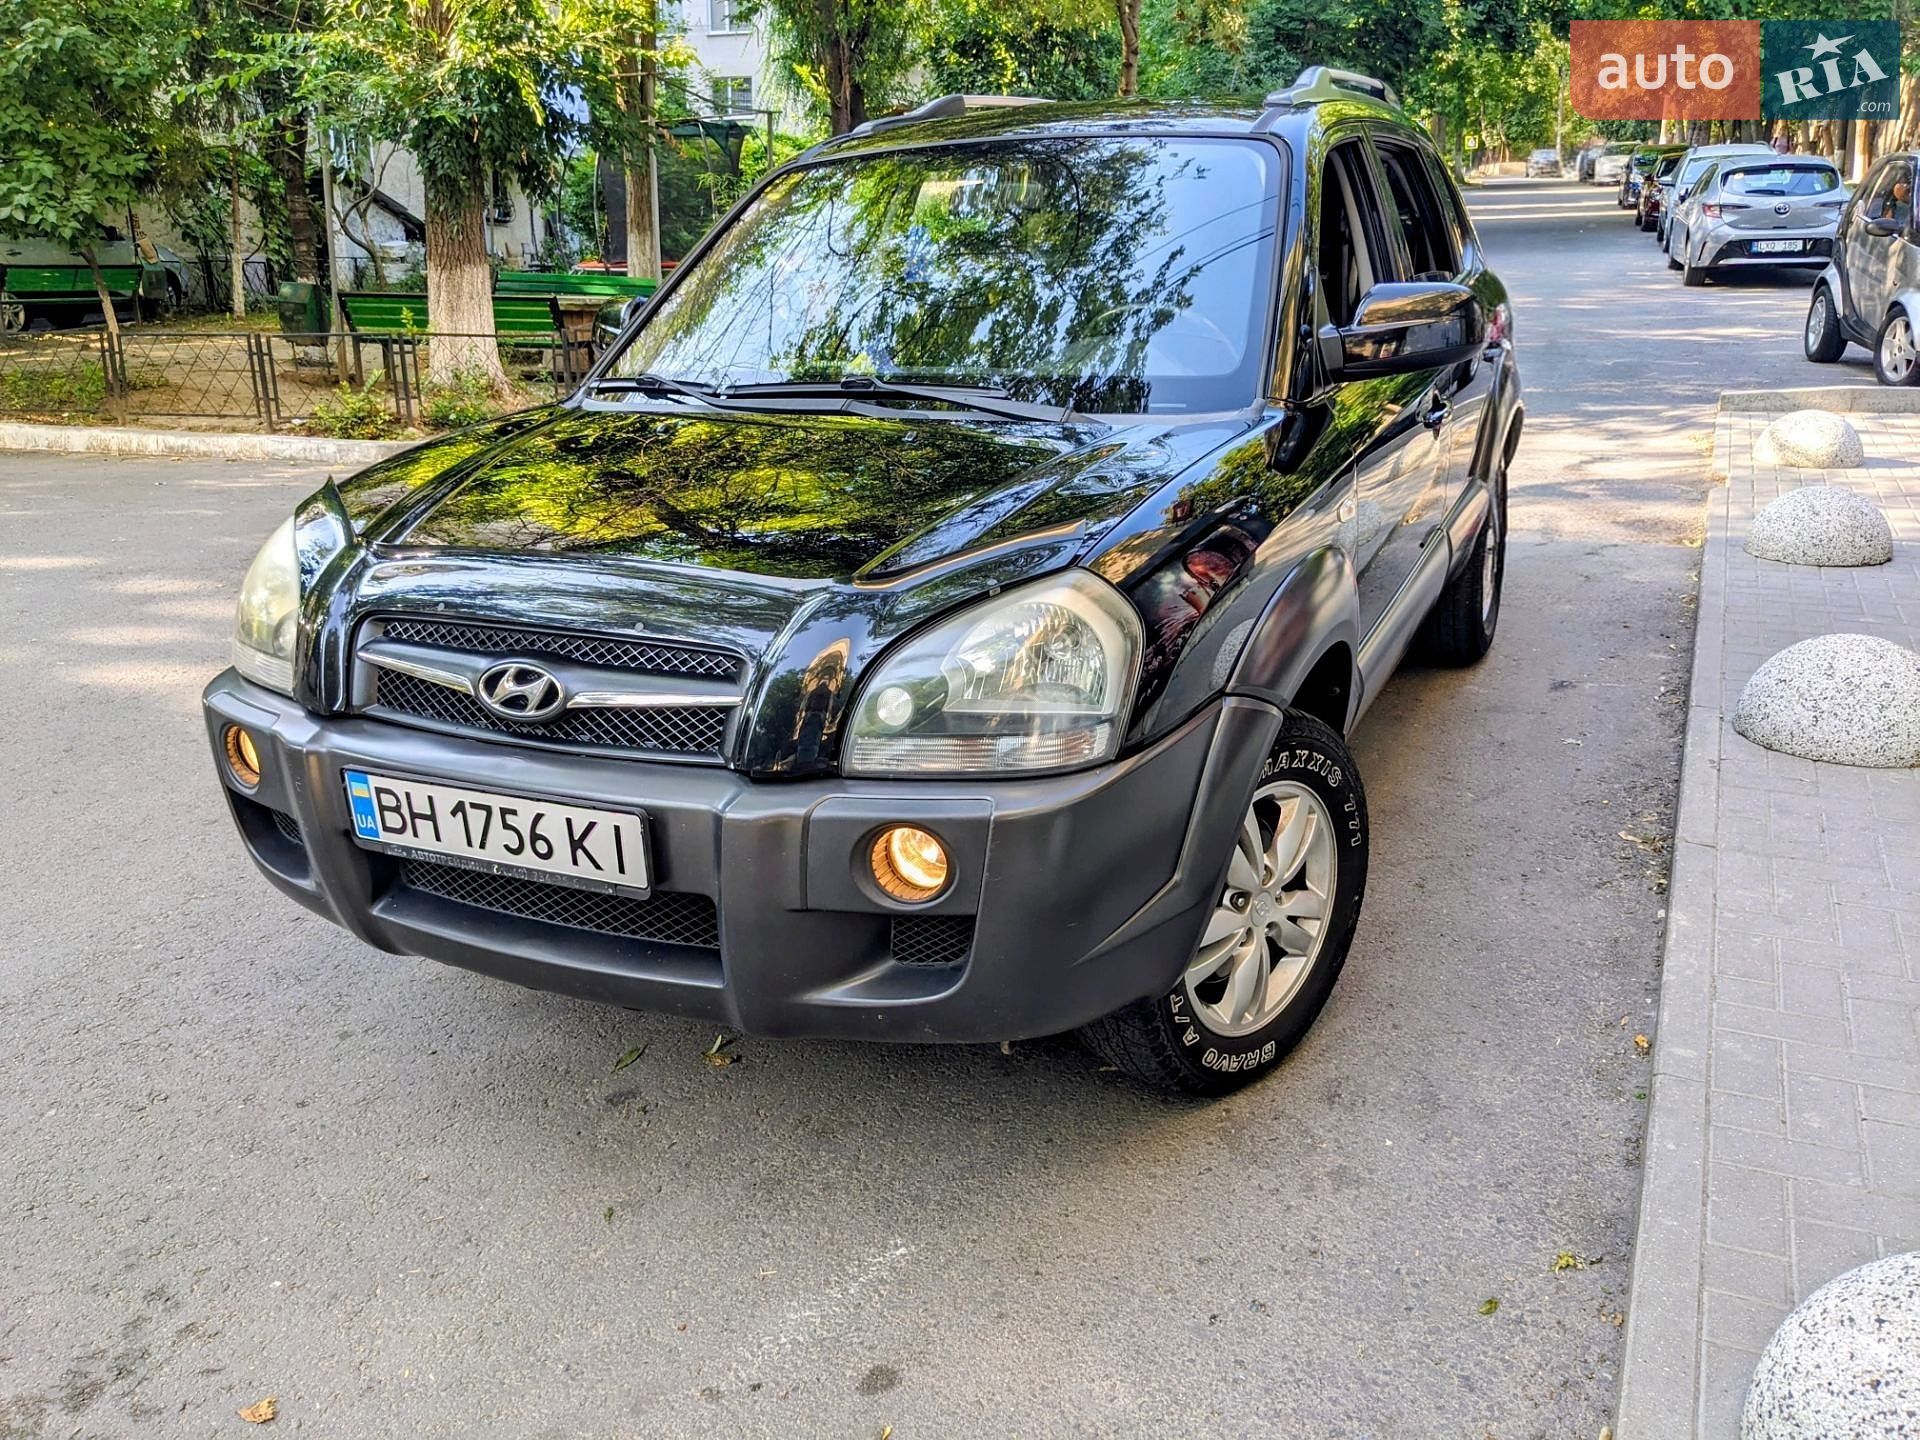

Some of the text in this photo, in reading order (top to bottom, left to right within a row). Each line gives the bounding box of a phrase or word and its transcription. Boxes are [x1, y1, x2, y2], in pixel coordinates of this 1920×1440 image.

[1257, 750, 1342, 787] MAXXIS
[357, 814, 376, 830] UA
[374, 786, 441, 842] BH
[450, 800, 554, 860] 1756
[1170, 994, 1276, 1072] BRAVO A/T
